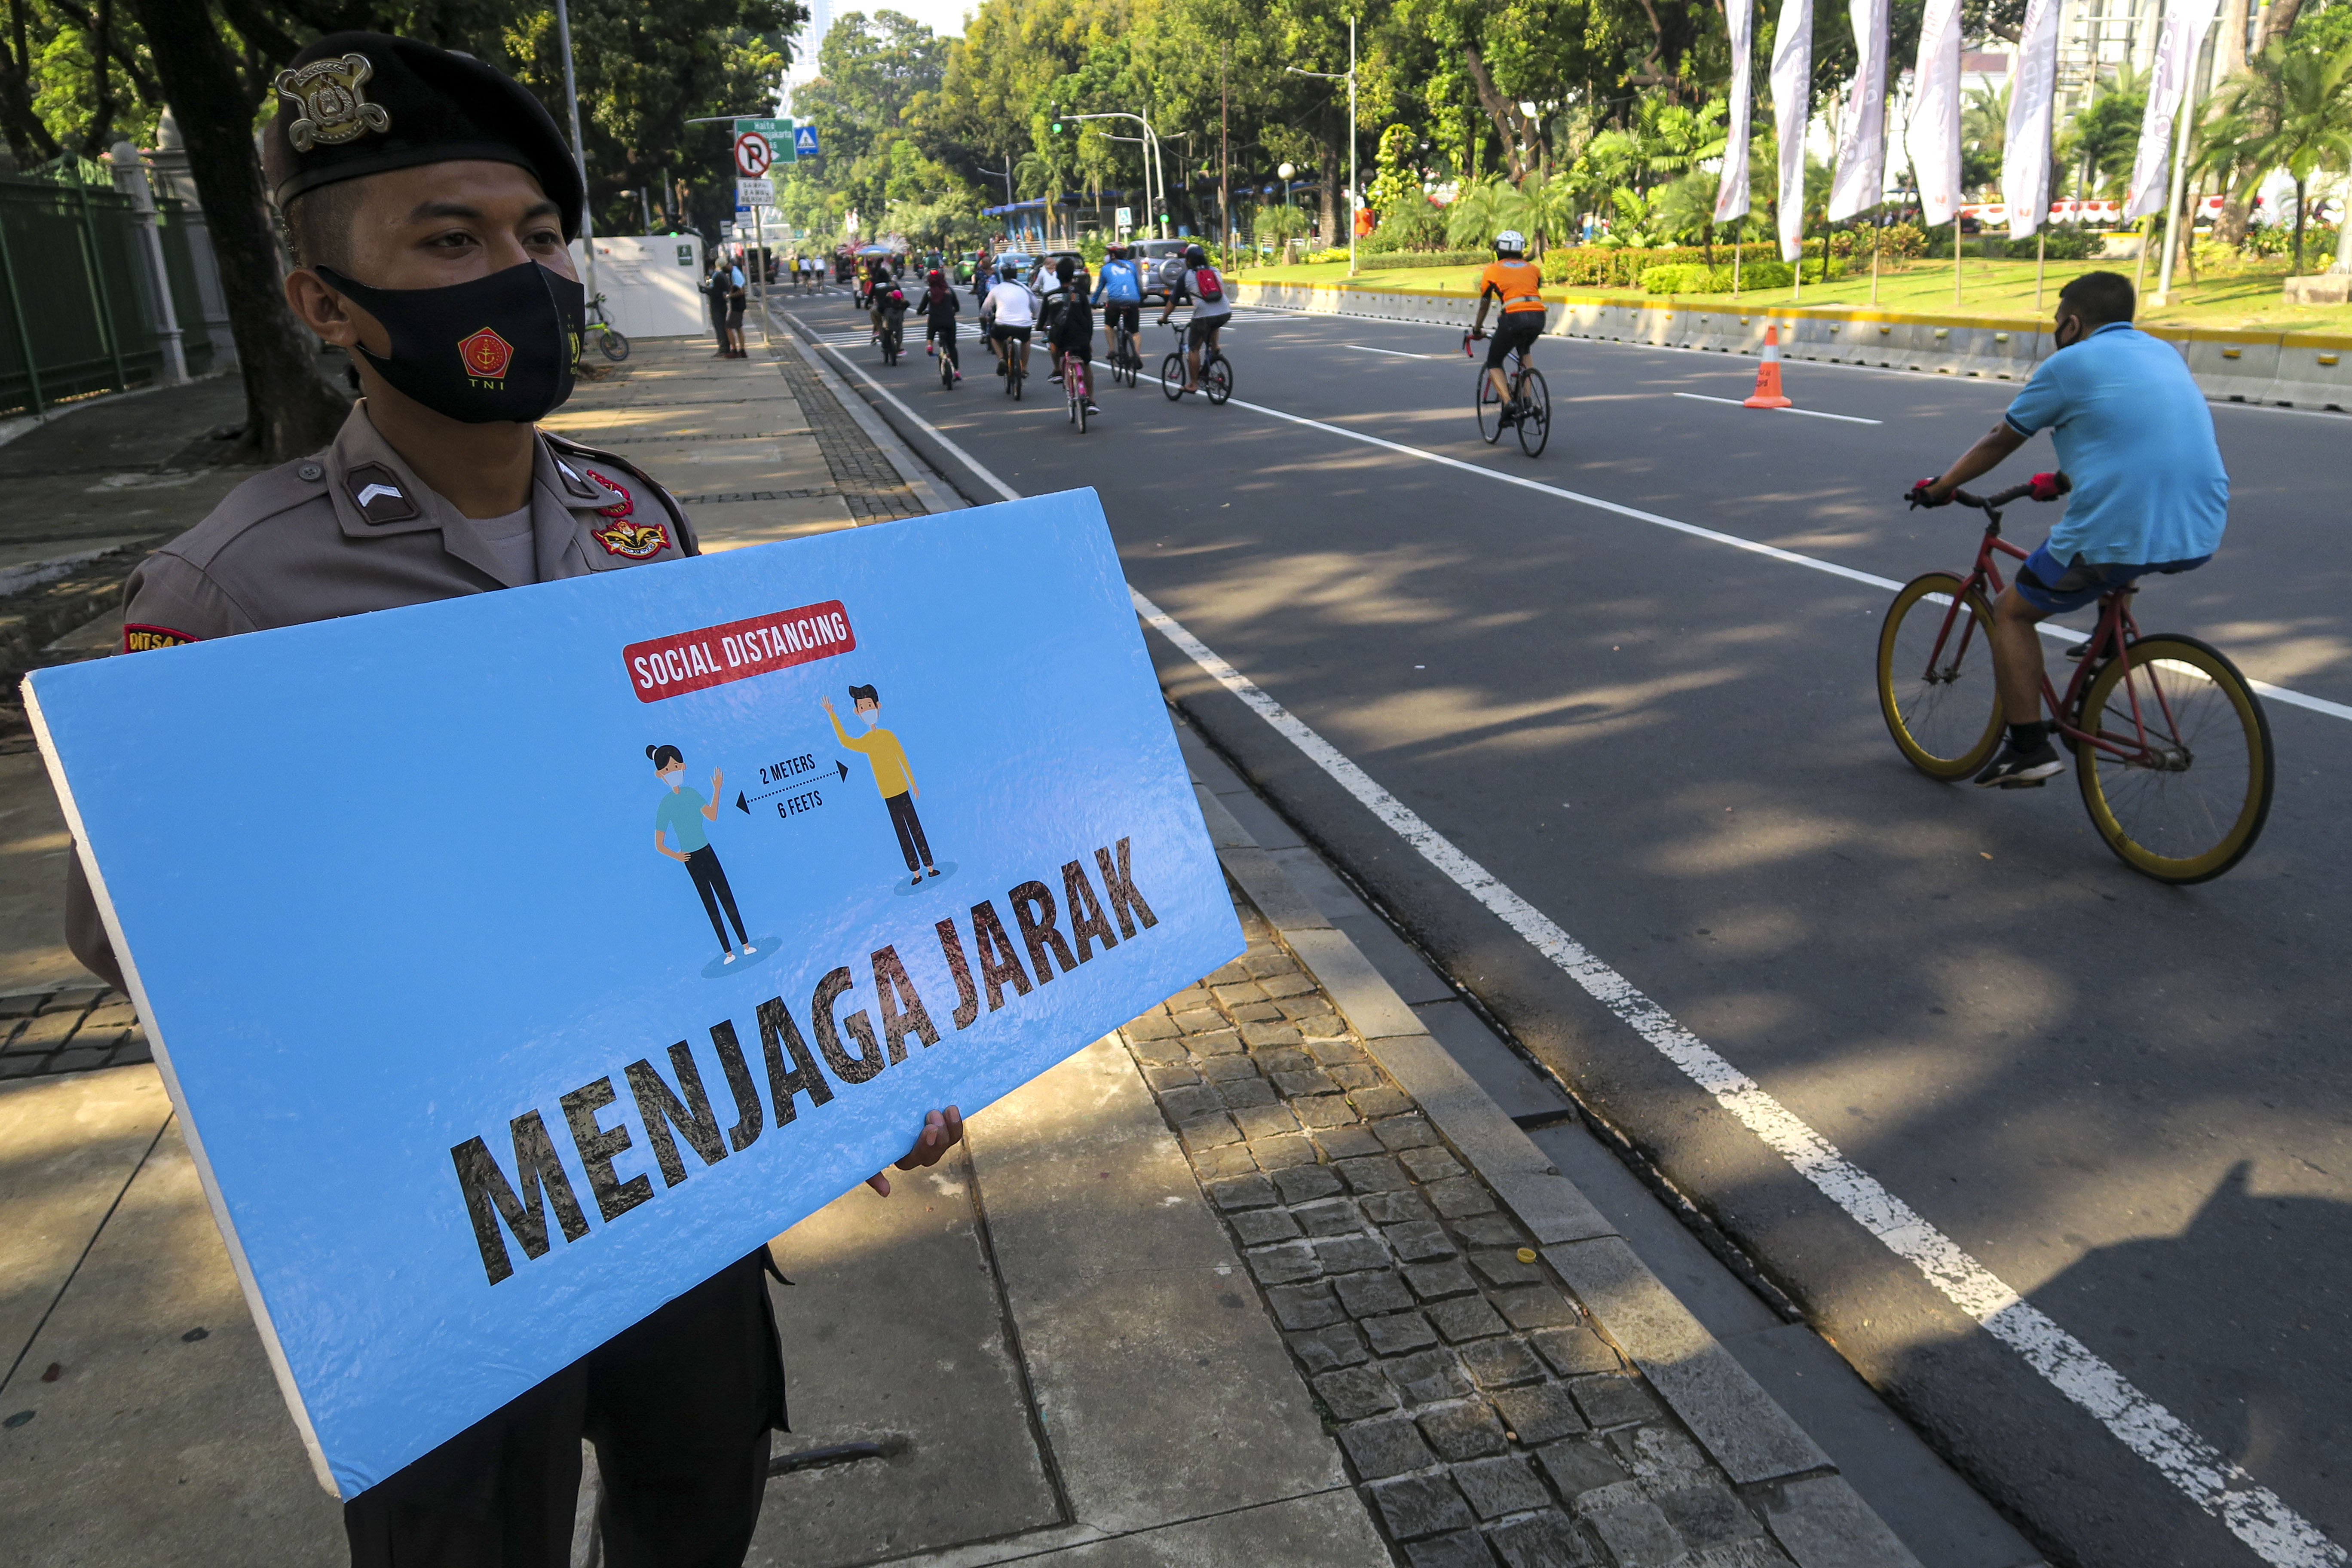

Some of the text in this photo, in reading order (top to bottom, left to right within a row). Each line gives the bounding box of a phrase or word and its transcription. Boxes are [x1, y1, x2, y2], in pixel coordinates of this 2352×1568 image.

[754, 121, 775, 129] Halte
[469, 379, 503, 390] TNI
[130, 631, 186, 650] DITSA
[634, 612, 847, 689] SOCIAL DISTANCING
[760, 753, 815, 784] 2 METERS
[777, 790, 823, 818] 6 FEETS
[450, 836, 1159, 1286] MENJAGA JARAK
